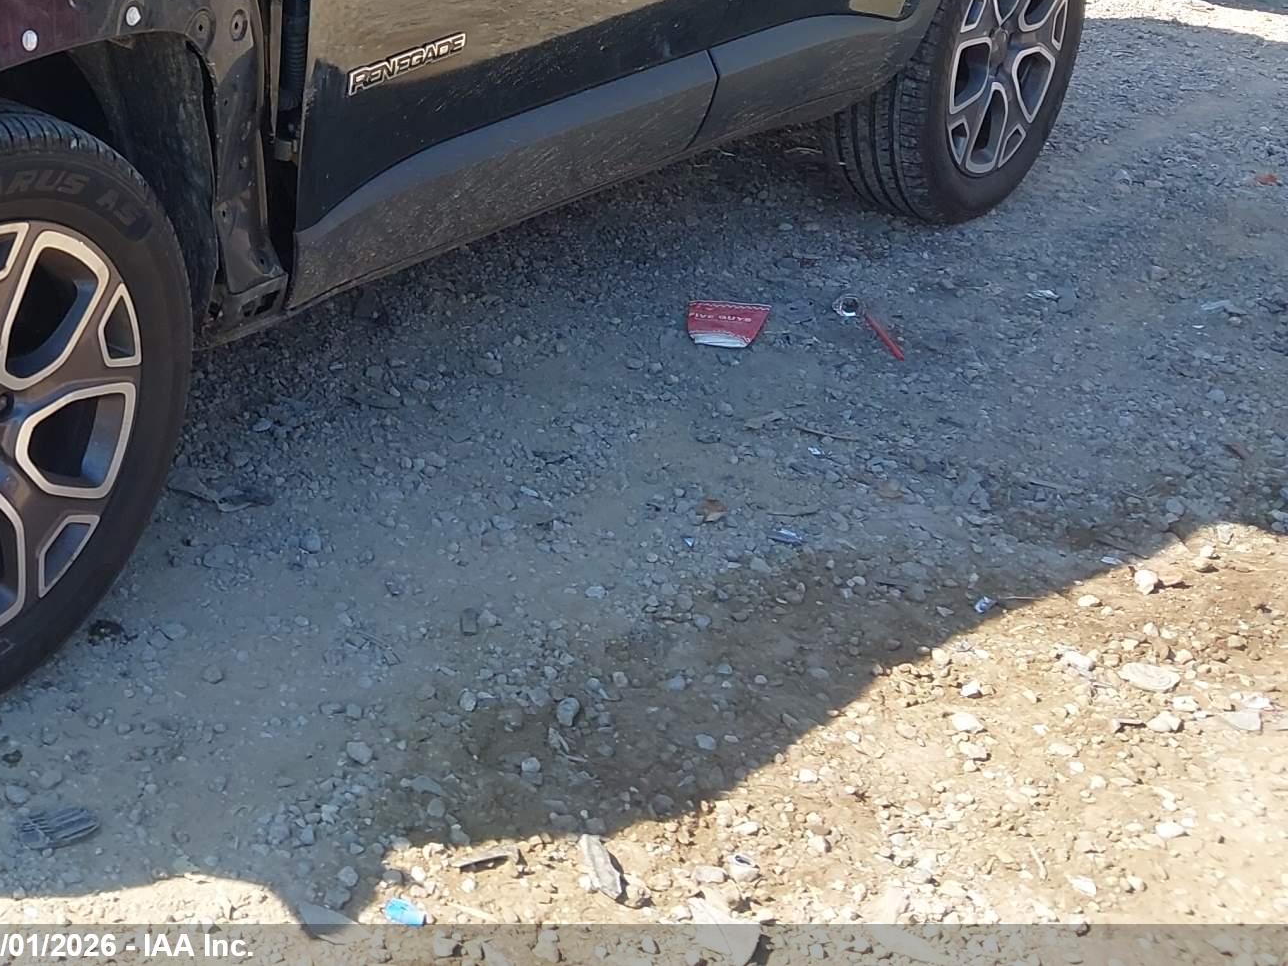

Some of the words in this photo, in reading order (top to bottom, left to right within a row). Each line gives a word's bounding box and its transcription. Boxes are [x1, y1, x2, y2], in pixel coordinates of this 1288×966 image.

[346, 32, 467, 97] RENEGADE
[95, 188, 144, 227] AS
[718, 315, 752, 323] GUYS
